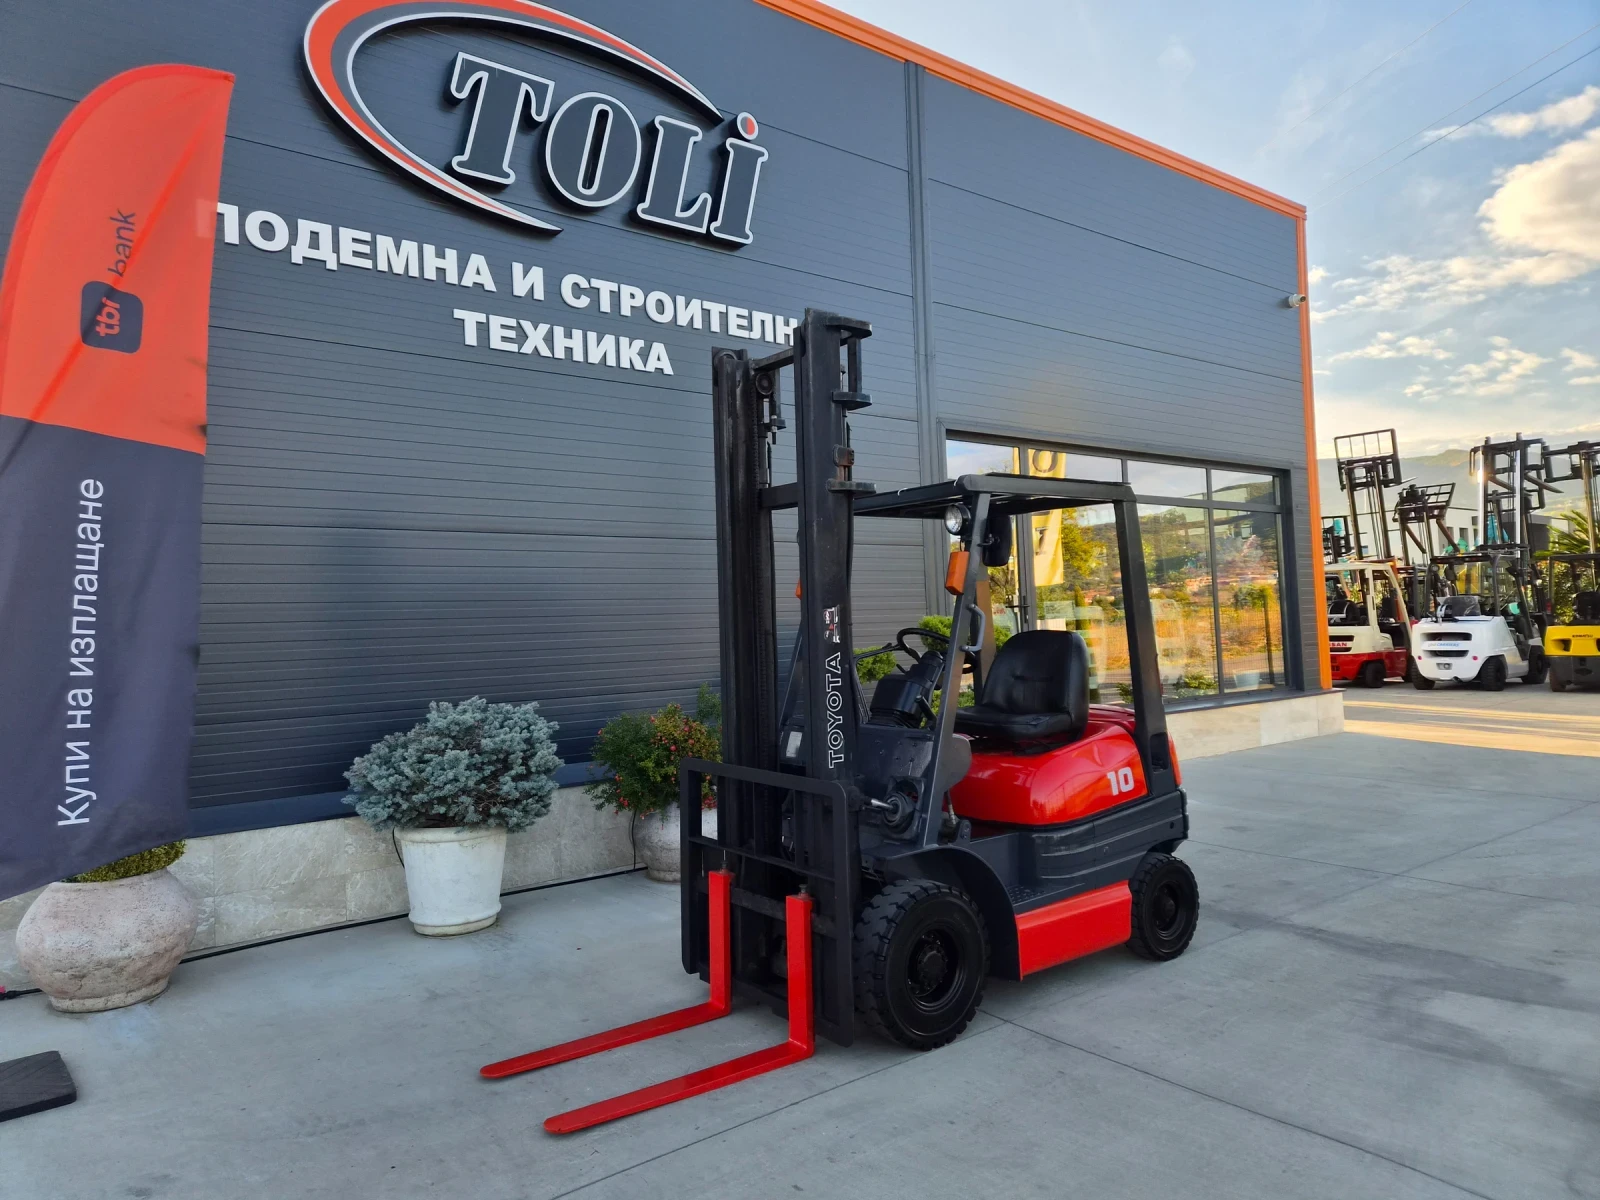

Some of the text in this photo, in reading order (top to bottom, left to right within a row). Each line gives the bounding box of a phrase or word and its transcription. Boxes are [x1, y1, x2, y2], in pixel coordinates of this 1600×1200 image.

[95, 208, 137, 337] tbi bank
[196, 199, 798, 347] ПОДЕМНА И СТРОИТЕЛН
[453, 308, 674, 376] ТЕХНИКА
[57, 478, 105, 827] Купи на изплащане
[825, 652, 845, 769] TOYOTA
[1106, 766, 1135, 797] 10
